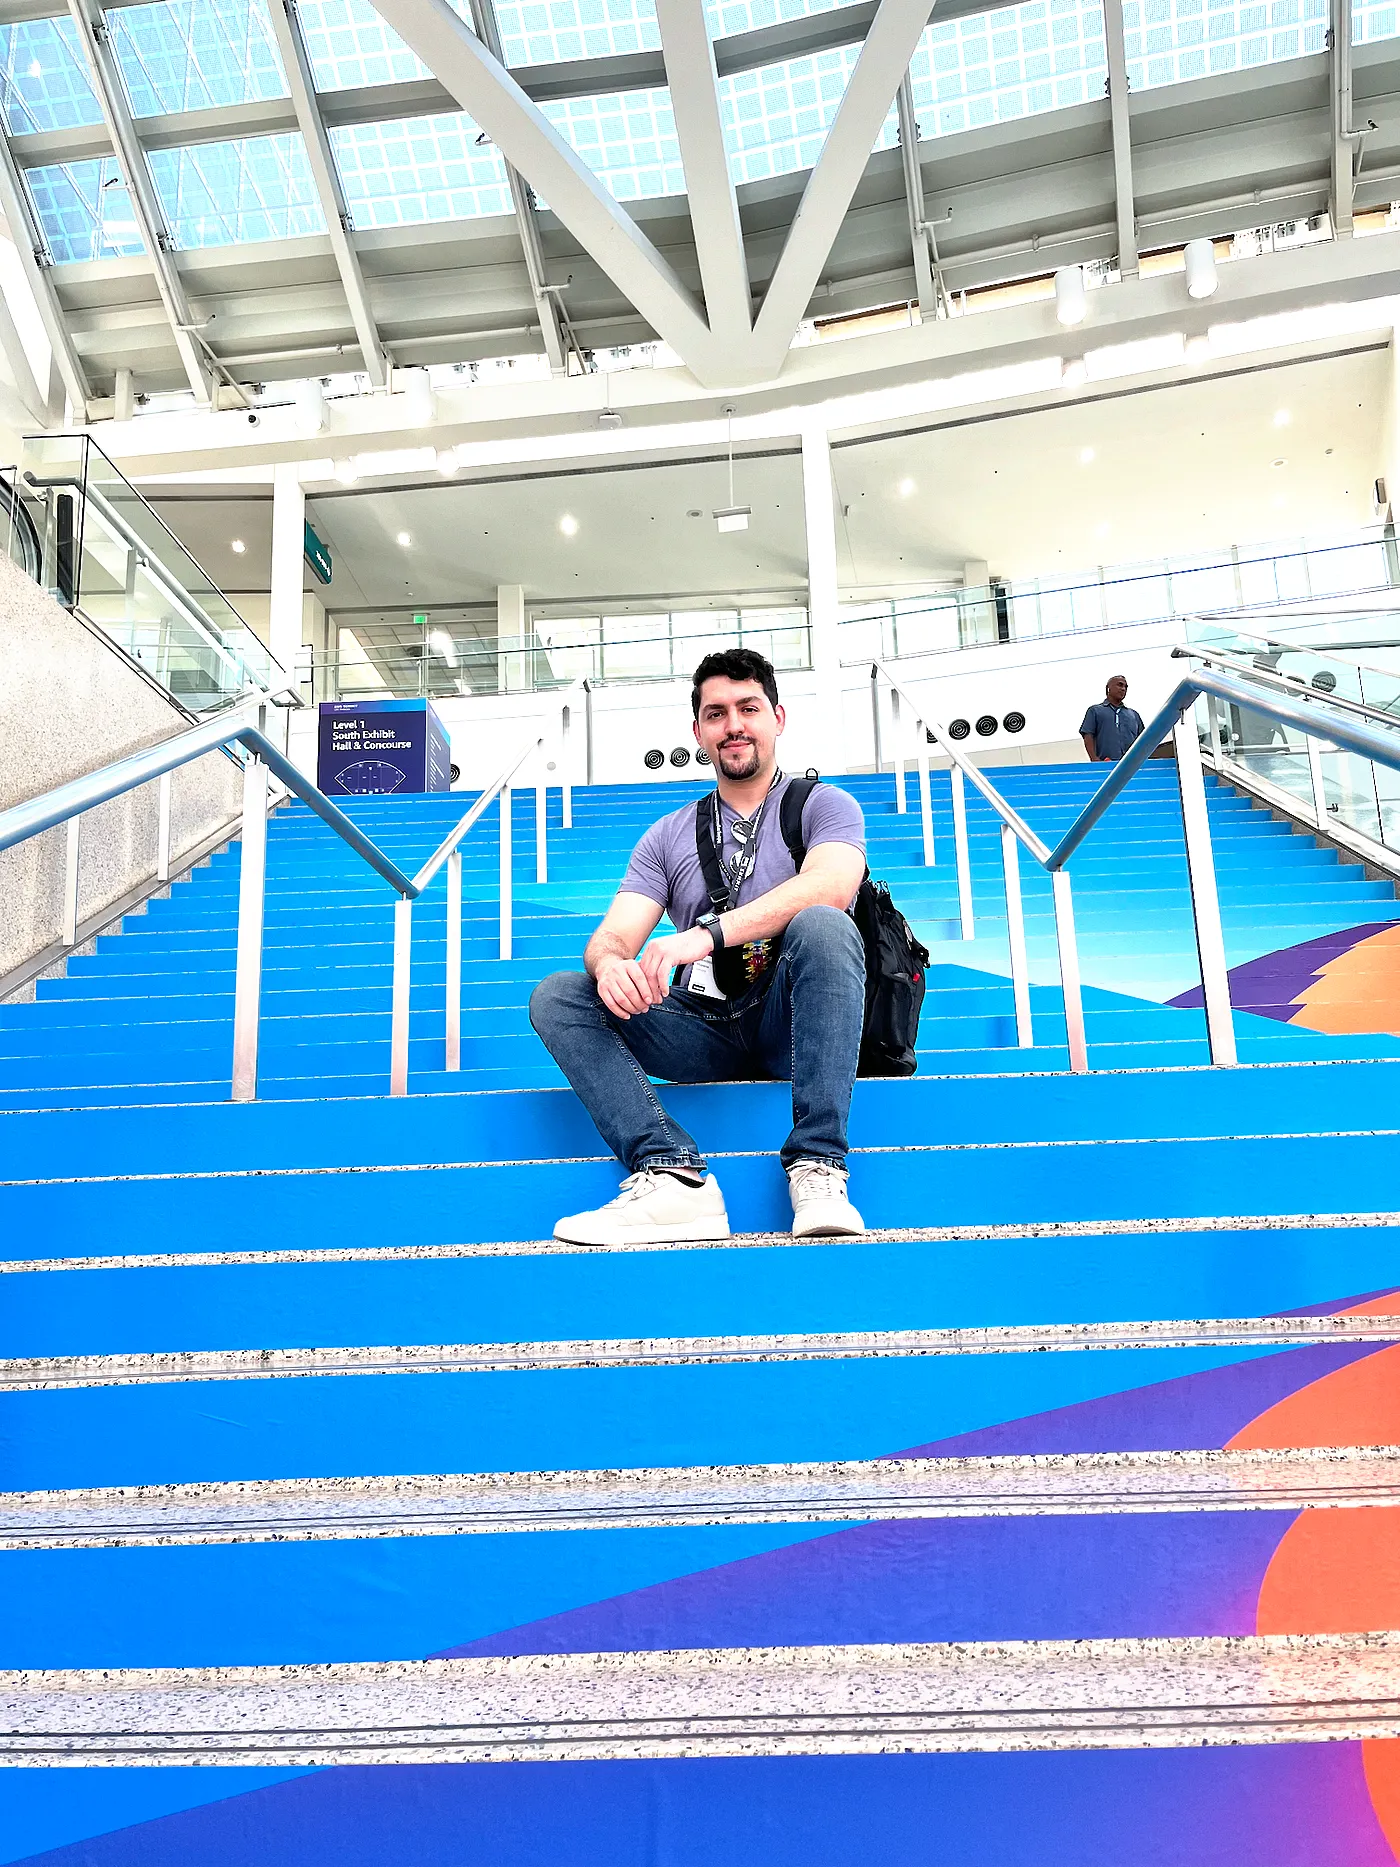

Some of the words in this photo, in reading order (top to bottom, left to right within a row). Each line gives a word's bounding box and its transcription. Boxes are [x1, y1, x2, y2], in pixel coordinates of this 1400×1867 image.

[333, 720, 357, 729] Level
[361, 720, 365, 729] 1
[333, 731, 360, 740] South
[363, 730, 395, 739] Exhibit
[333, 741, 352, 750] Hall
[354, 741, 362, 750] &
[363, 741, 411, 749] Concourse
